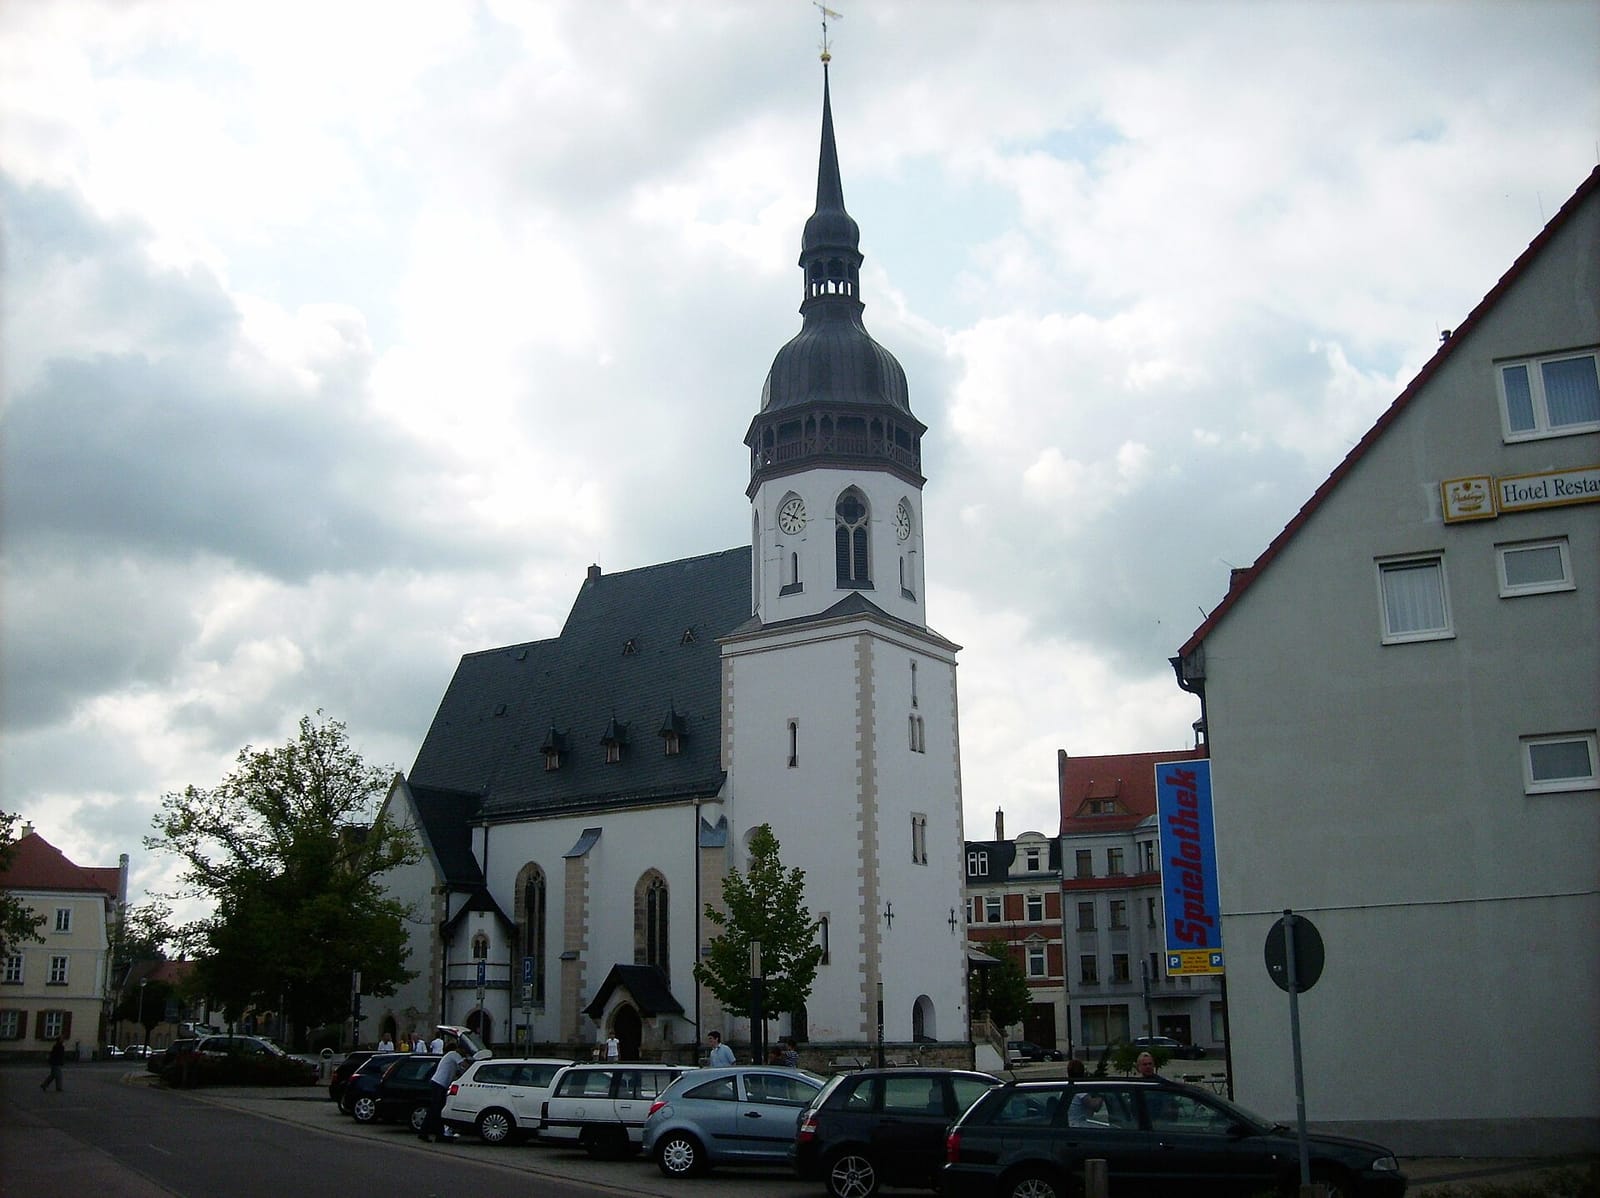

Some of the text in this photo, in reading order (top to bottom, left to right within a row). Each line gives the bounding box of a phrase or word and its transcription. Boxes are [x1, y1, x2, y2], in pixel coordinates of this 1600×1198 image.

[1504, 480, 1548, 502] Hotel
[1554, 476, 1600, 497] Resta
[1166, 769, 1213, 946] Spielothek
[1171, 957, 1178, 966] P
[1212, 955, 1220, 964] P
